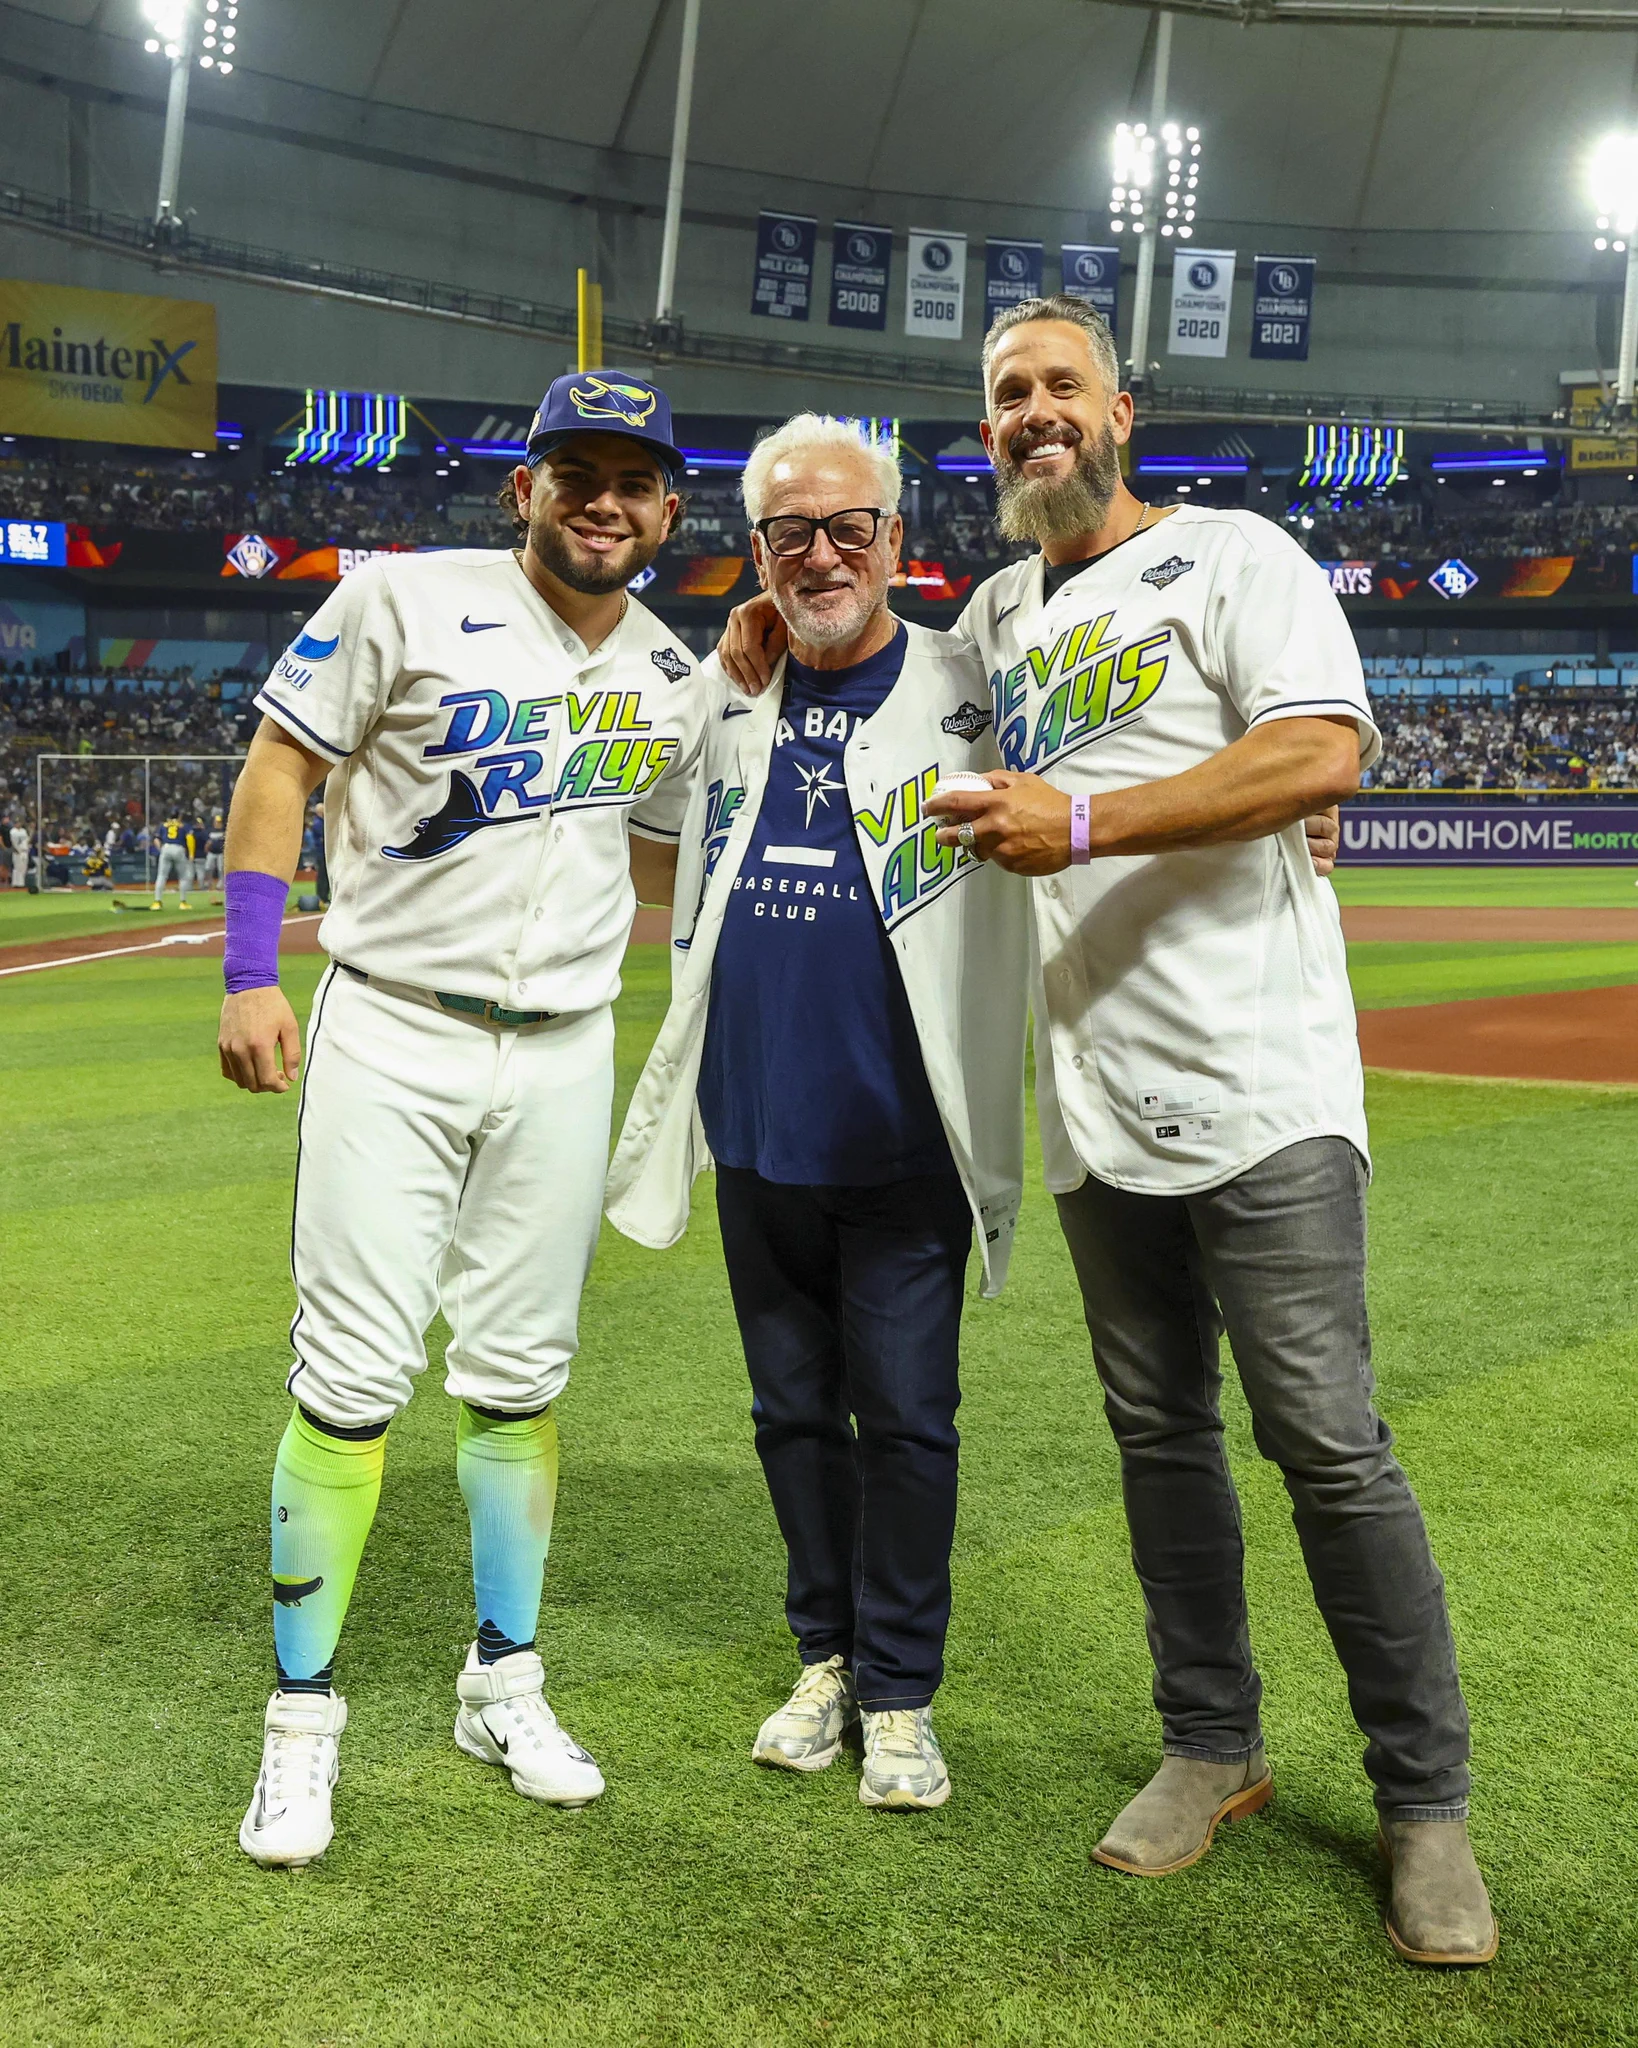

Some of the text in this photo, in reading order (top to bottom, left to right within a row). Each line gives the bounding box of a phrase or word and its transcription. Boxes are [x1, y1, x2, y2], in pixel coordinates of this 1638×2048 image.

[837, 290, 880, 313] 2008
[913, 299, 956, 321] 2008
[1177, 318, 1220, 339] 2020
[1260, 322, 1300, 344] 2021
[50, 380, 124, 404] SKYDECK
[990, 610, 1123, 736] DEVIL
[1000, 630, 1172, 772] RAYS
[424, 689, 652, 757] DEVIL
[475, 738, 680, 813] RAYS
[1075, 804, 1086, 821] RF
[733, 876, 859, 901] BASEBALL
[754, 902, 817, 922] CLUB
